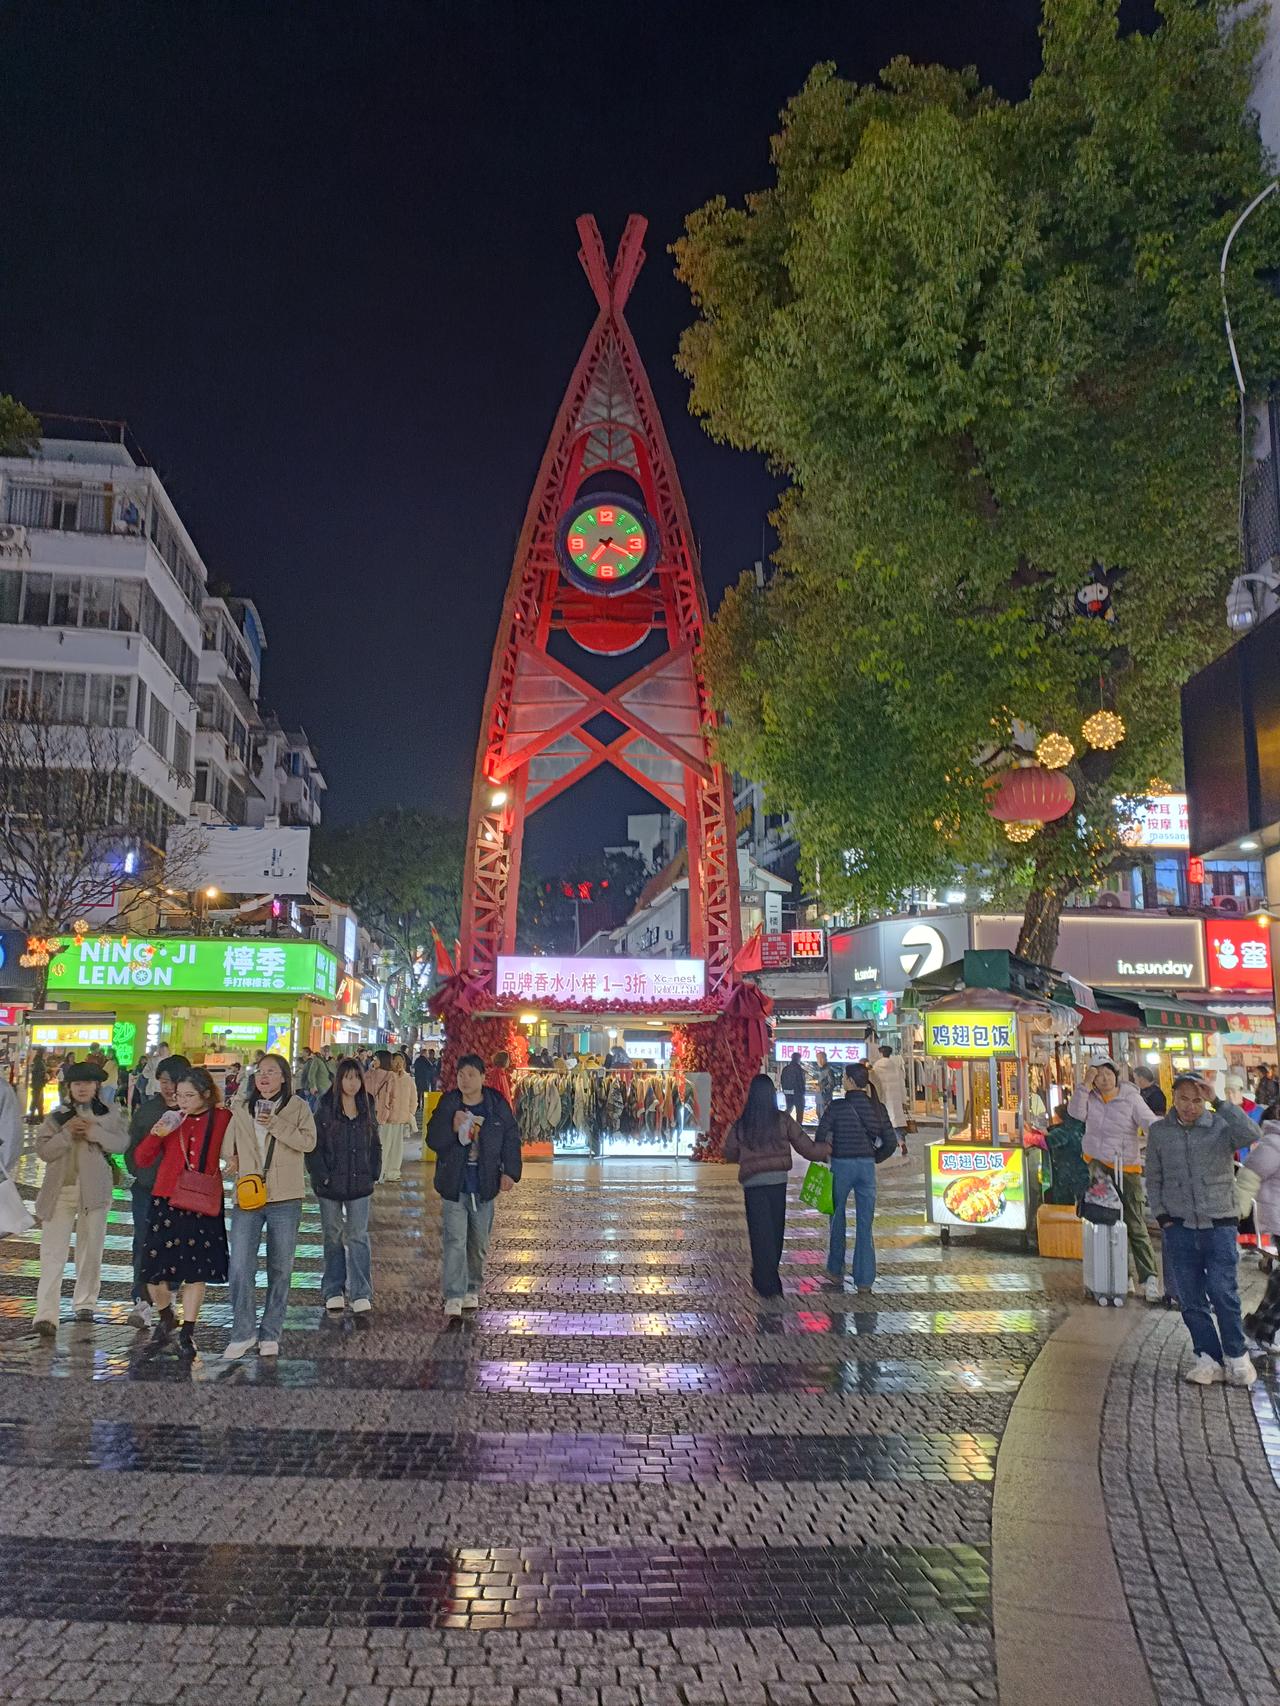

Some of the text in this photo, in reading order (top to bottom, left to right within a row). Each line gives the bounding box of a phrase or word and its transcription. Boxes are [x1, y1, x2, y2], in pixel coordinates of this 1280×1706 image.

[600, 510, 613, 522] 12
[571, 538, 584, 550] 9
[630, 538, 642, 549] 3
[601, 565, 613, 577] 6
[1240, 940, 1268, 969] 蜜
[78, 965, 173, 986] LEMON
[1117, 959, 1193, 978] in.sunday
[502, 972, 597, 993] 品牌香水小样
[932, 1024, 1011, 1047] 鸡翅包饭
[942, 1153, 1004, 1170] 鸡翅包饭
